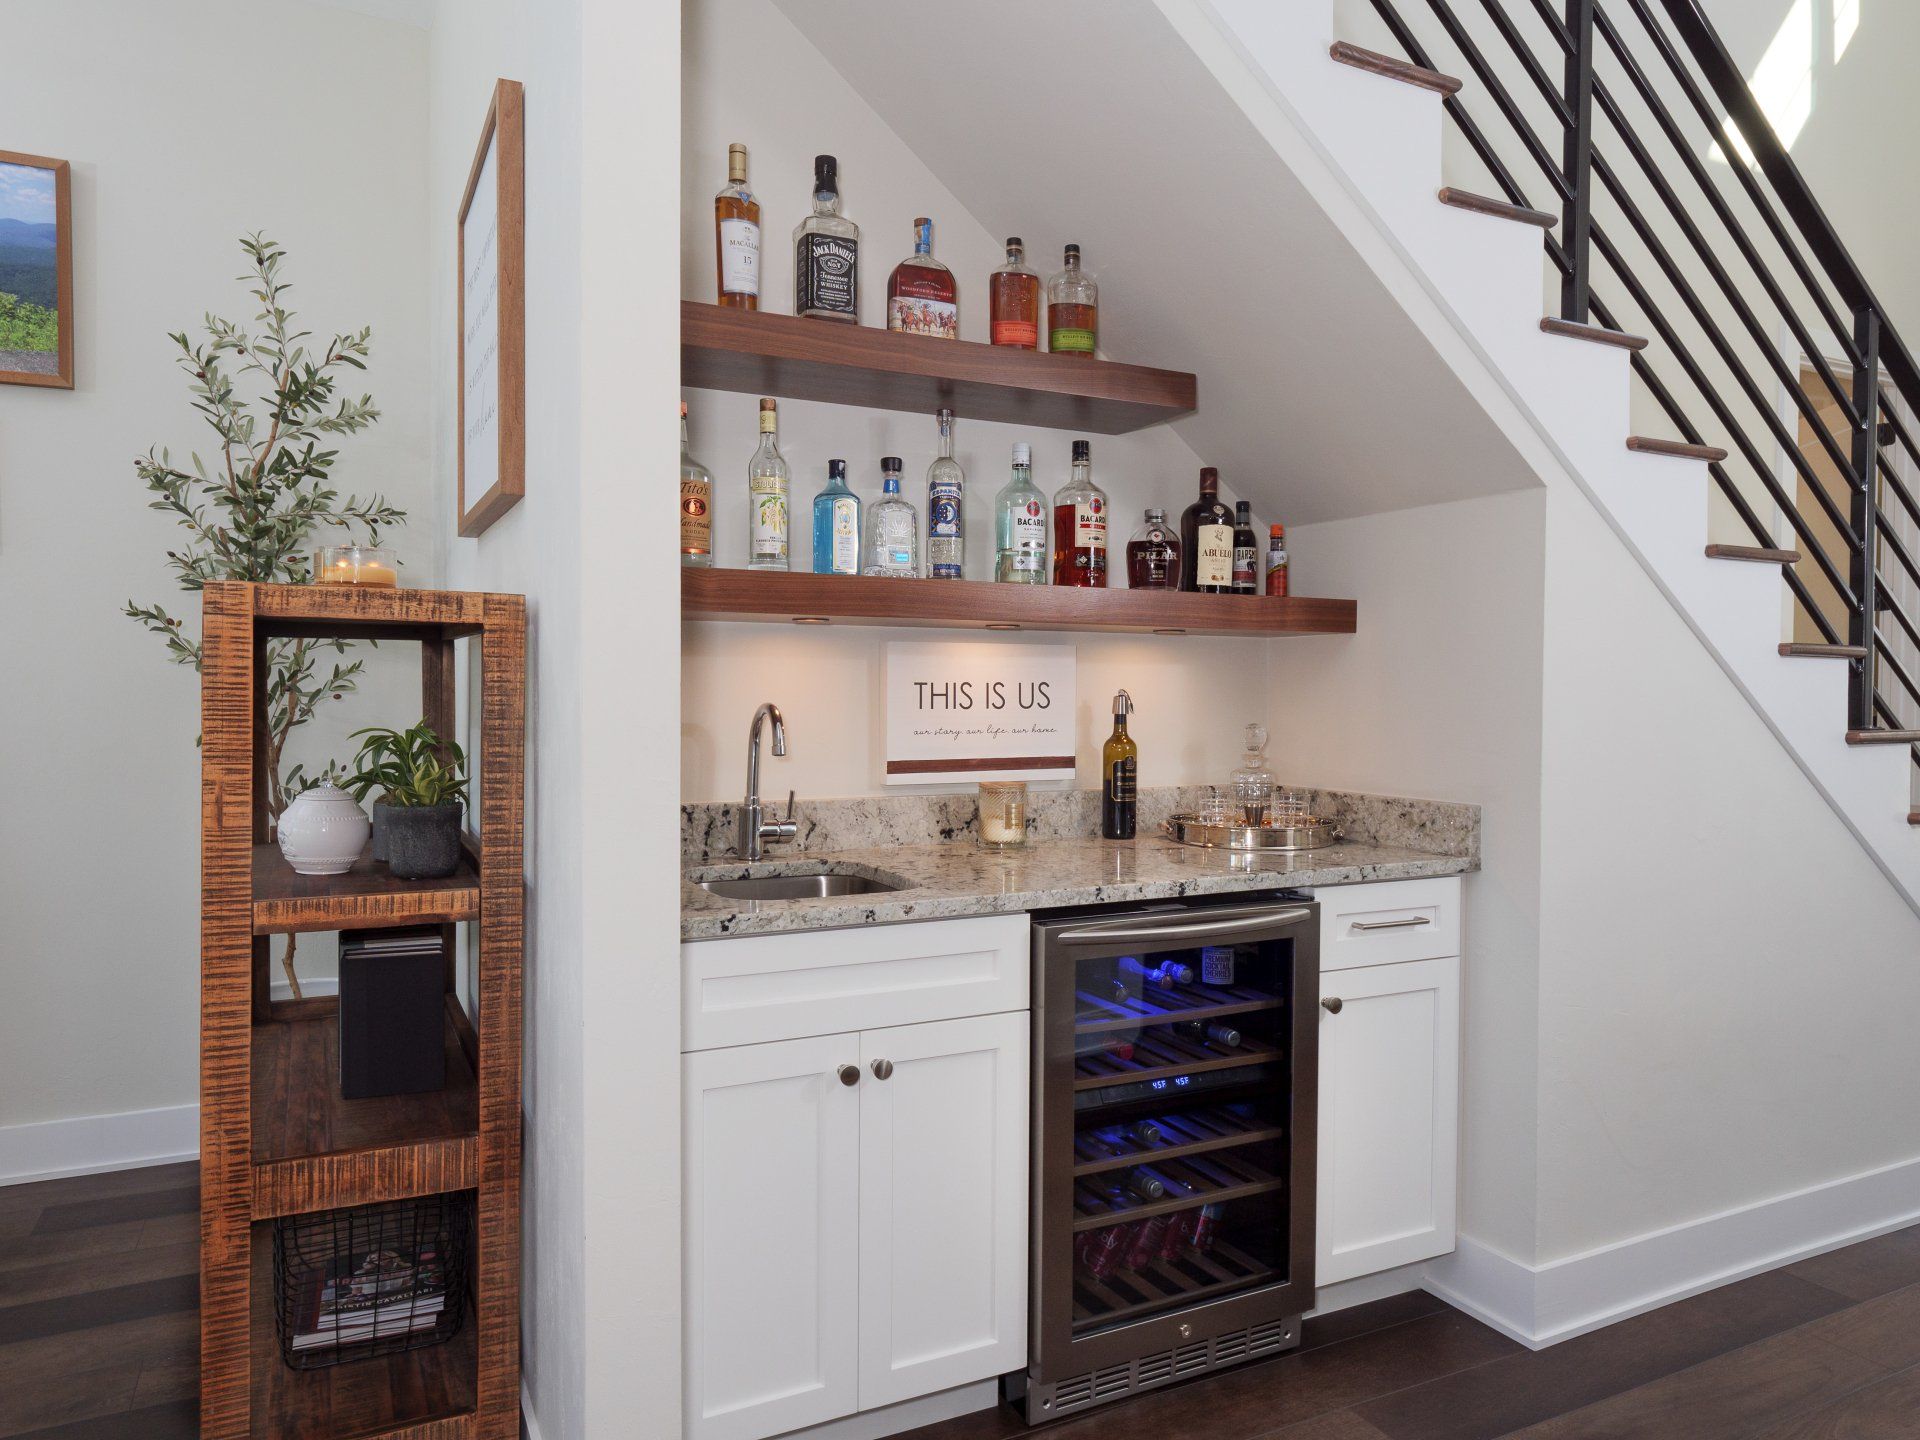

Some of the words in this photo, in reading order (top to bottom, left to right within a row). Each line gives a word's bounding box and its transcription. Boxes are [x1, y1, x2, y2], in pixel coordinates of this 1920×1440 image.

[813, 244, 830, 258] JACK
[829, 242, 855, 265] DANIEL'S
[820, 281, 848, 290] WHISKEY
[681, 481, 709, 496] Tito's
[1080, 515, 1105, 524] BACARD
[1136, 551, 1178, 560] PILAR
[1202, 548, 1232, 559] ABUELO
[913, 681, 973, 710] THIS
[986, 681, 1006, 710] IS
[1018, 681, 1051, 710] US
[1152, 1079, 1166, 1089] 45F
[1175, 1076, 1189, 1085] 45F
[376, 1287, 433, 1304] CAVALLARI
